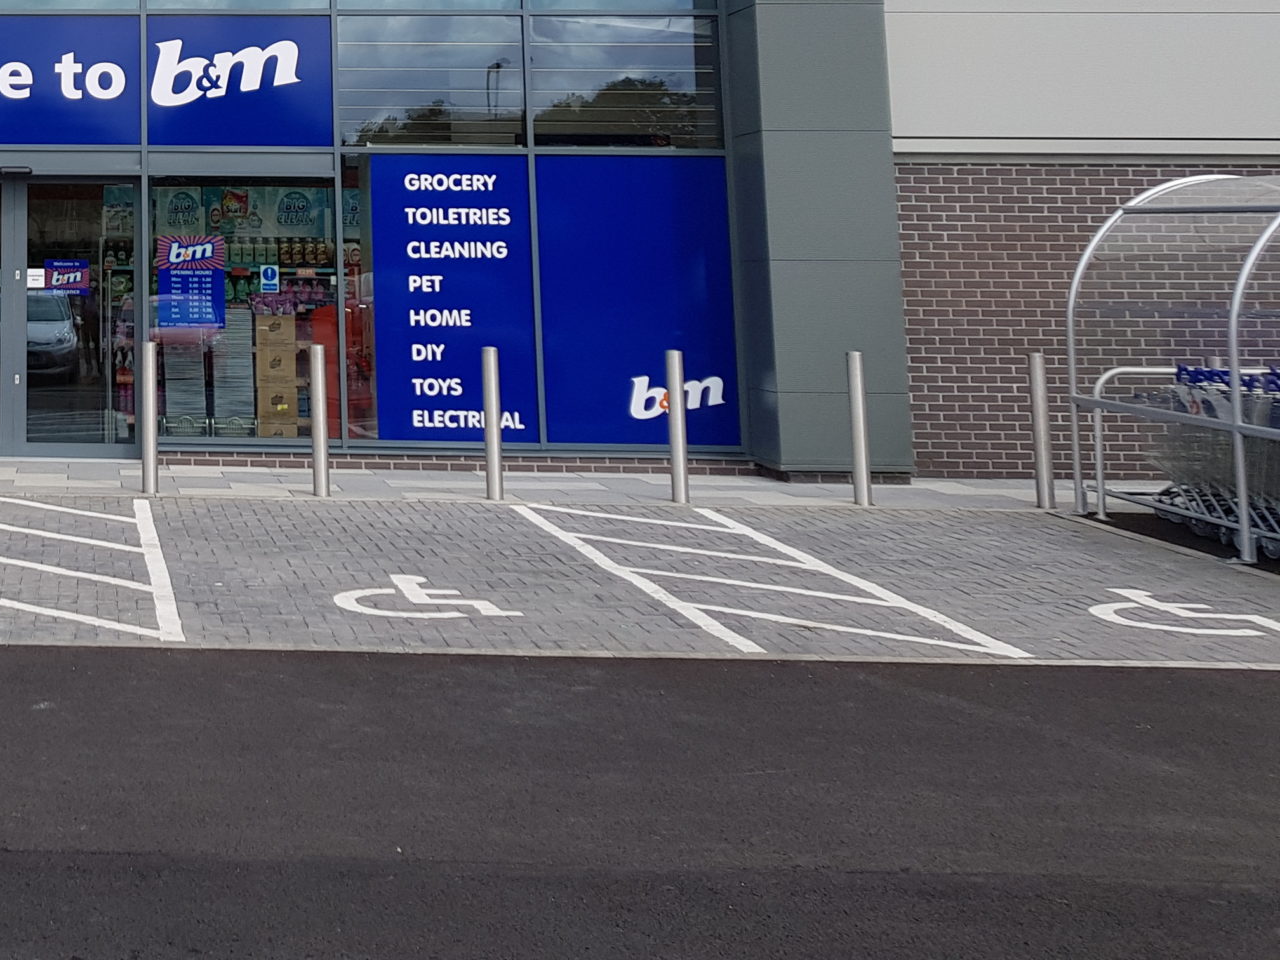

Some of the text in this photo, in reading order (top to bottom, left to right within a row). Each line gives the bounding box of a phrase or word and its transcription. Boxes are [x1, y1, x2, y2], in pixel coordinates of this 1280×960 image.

[55, 52, 125, 99] to
[151, 40, 300, 106] b&m
[404, 174, 496, 191] GROCERY
[285, 198, 307, 211] BIG
[405, 208, 510, 225] TOILETRIES
[169, 241, 213, 263] b&m
[407, 241, 507, 258] CLEANING
[409, 276, 443, 292] PET
[410, 309, 471, 326] HOME
[412, 344, 444, 361] DIY
[412, 378, 462, 395] TOYS
[413, 410, 526, 429] ELECTRIAL
